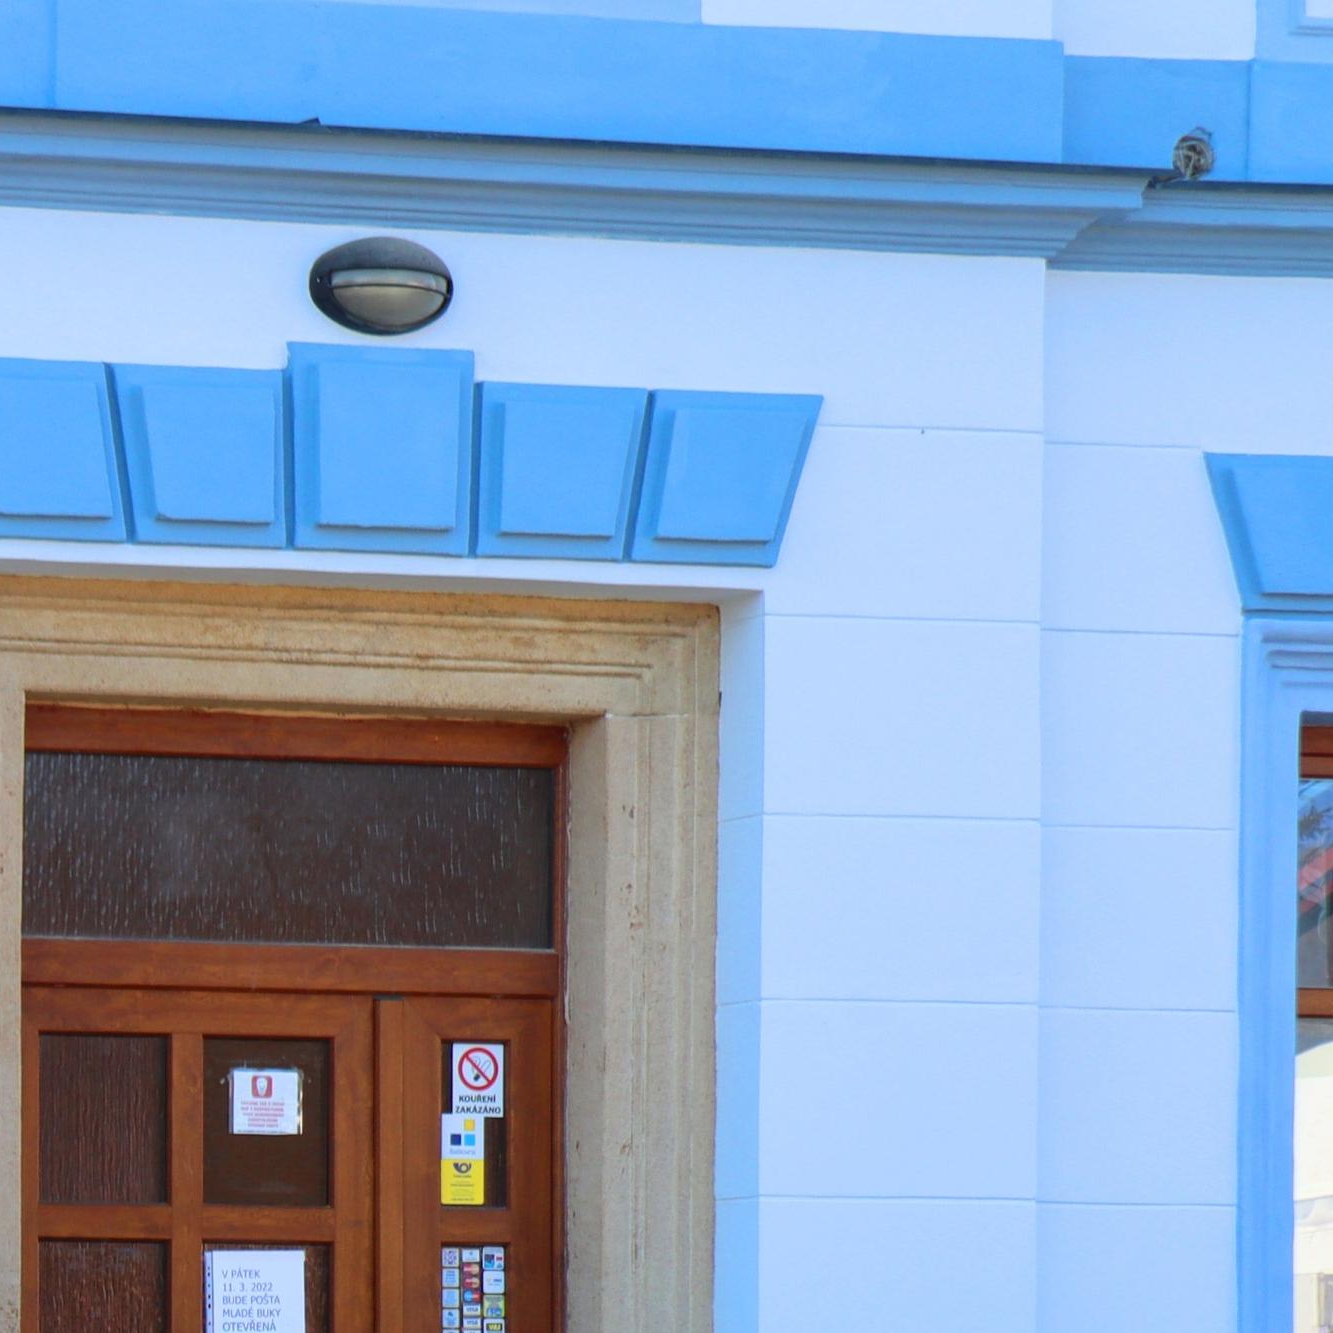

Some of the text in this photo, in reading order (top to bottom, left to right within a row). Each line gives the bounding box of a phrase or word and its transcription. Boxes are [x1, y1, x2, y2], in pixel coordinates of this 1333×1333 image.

[458, 1094, 497, 1103] KOUŘENÍ
[455, 1105, 502, 1114] ZAKÁZÁNO
[221, 1267, 261, 1279] V PÁTEK
[252, 1282, 273, 1293] 2022
[222, 1294, 281, 1305] BUDE POŠTA
[222, 1306, 282, 1318] MLADÉ BUKY
[222, 1319, 277, 1332] OTEVŘENÁ
